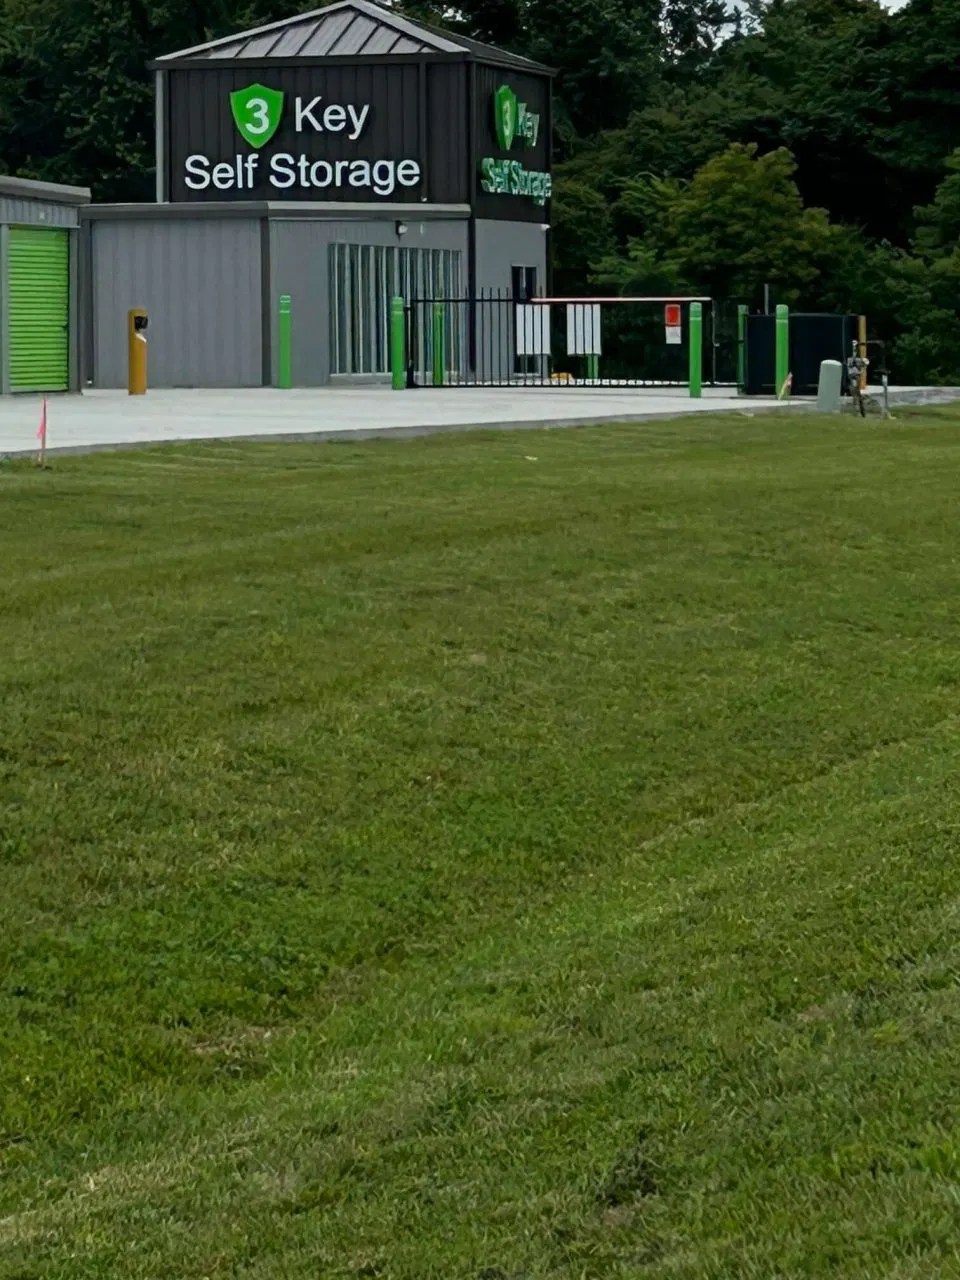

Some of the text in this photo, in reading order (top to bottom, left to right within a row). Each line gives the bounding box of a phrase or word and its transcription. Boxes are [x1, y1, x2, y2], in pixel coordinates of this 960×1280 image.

[245, 96, 369, 140] 3 Key
[517, 103, 540, 147] Key
[185, 153, 420, 195] Self Storage
